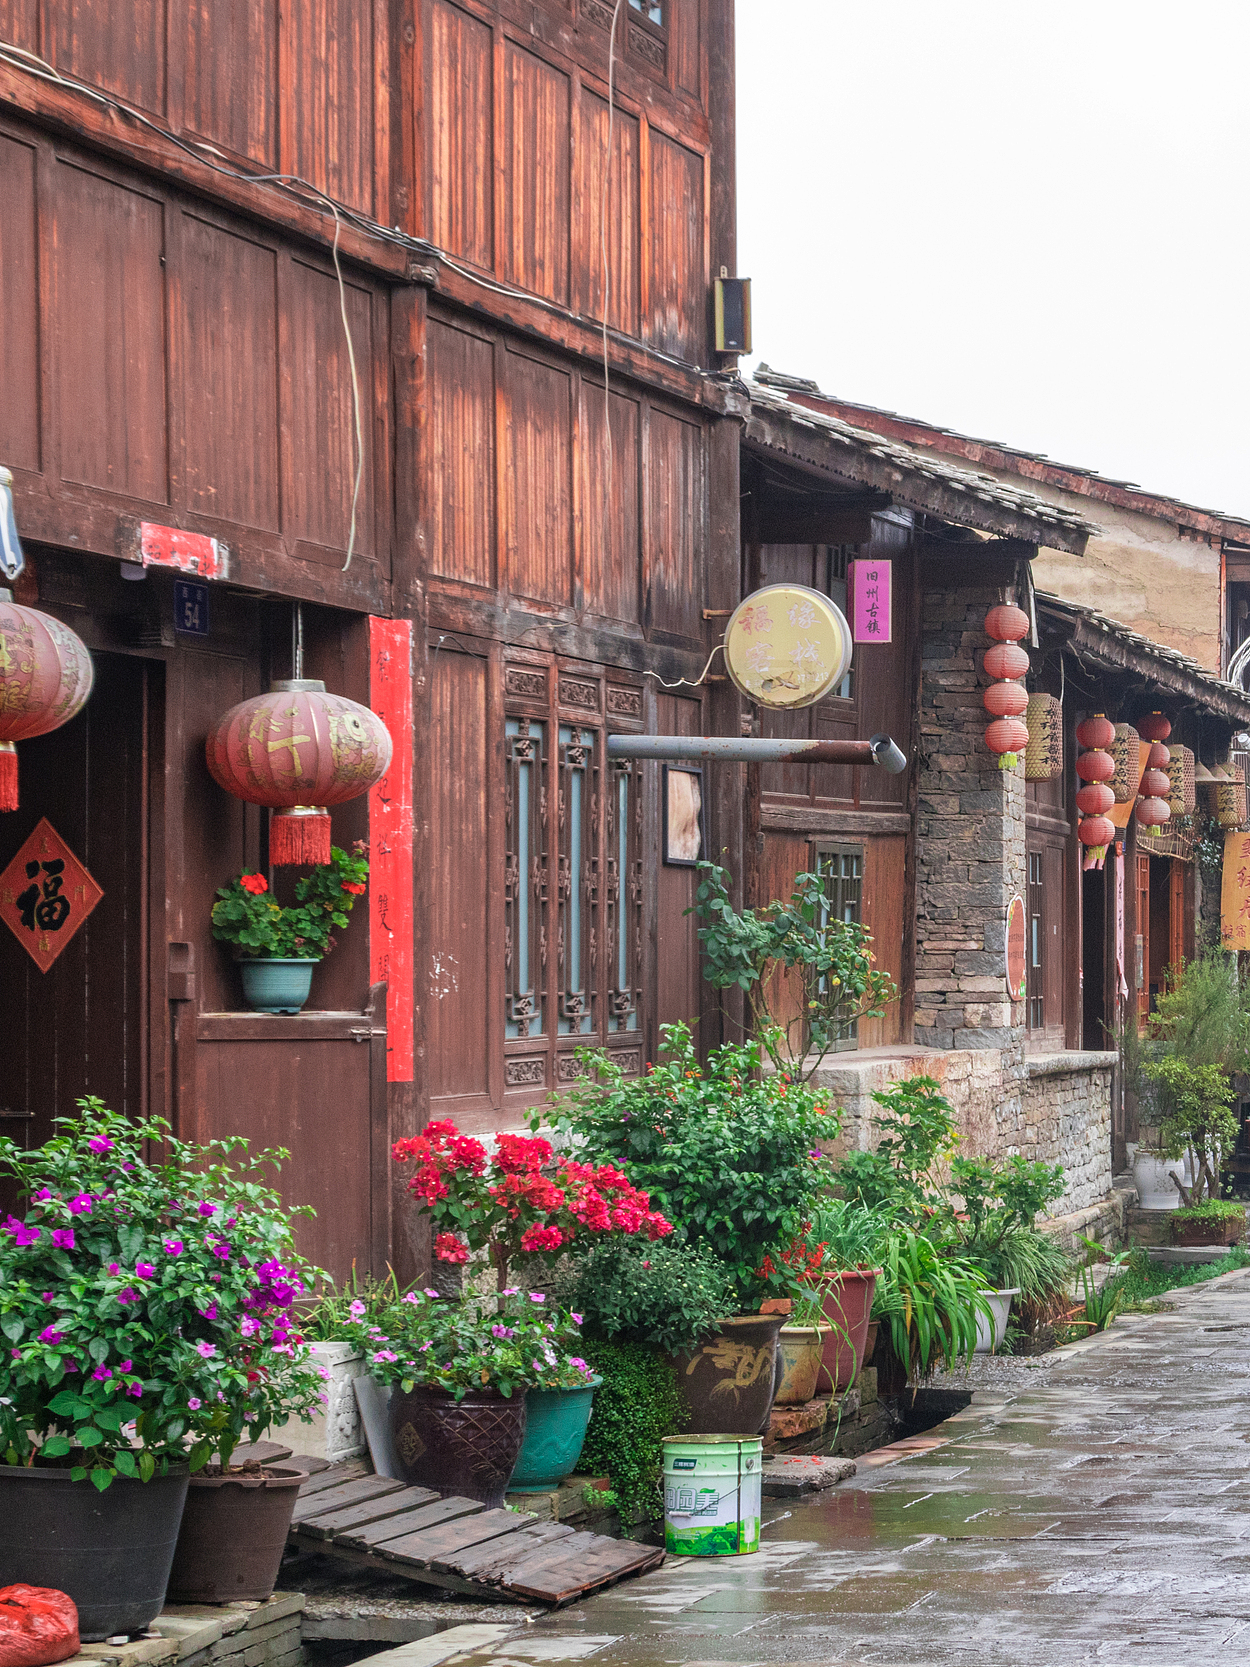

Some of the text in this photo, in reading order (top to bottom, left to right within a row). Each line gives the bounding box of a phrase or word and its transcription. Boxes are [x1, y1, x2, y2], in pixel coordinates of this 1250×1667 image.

[184, 602, 200, 629] 54
[865, 571, 881, 634] 旧州古镇
[16, 858, 71, 932] 福
